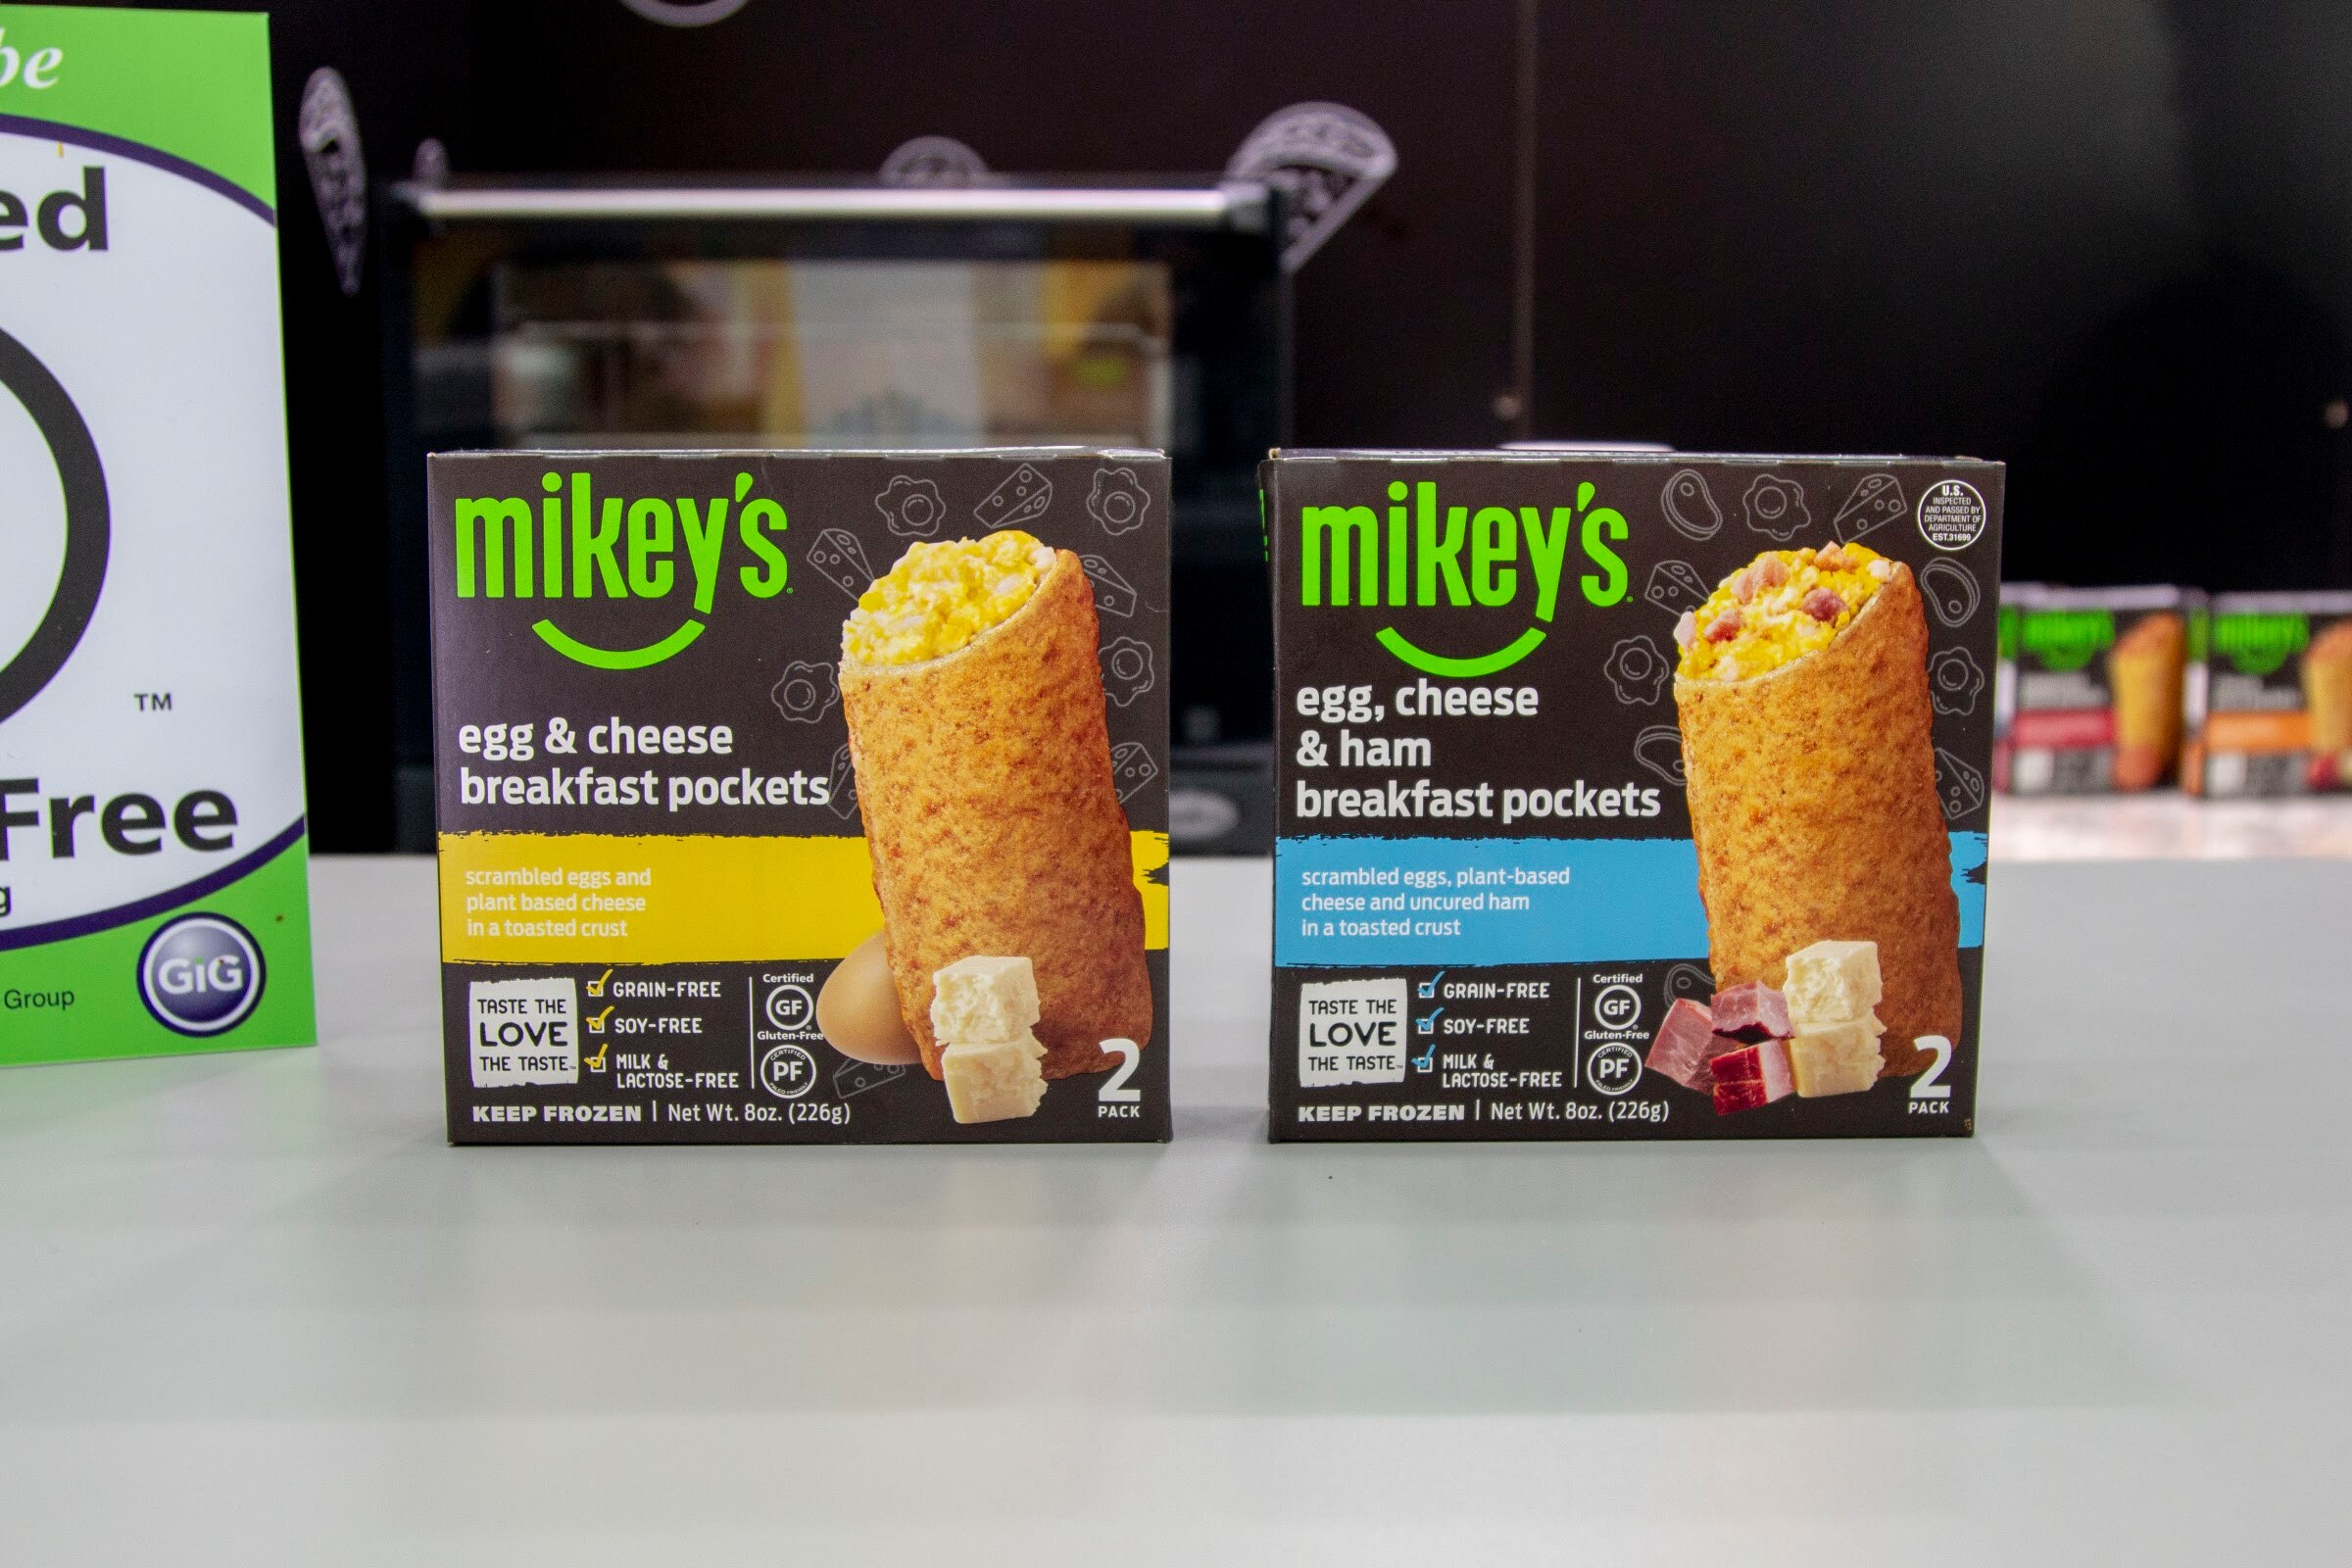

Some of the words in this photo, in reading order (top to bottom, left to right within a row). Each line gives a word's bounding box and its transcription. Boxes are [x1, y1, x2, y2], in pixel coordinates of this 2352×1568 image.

[1942, 485, 1964, 496] U.S.
[1926, 506, 1940, 514] AND
[1942, 506, 1969, 514] PASSED
[1971, 506, 1981, 514] BY
[1933, 497, 1972, 506] INSPECTED
[1972, 514, 1982, 523] OF
[1928, 523, 1977, 532] AGRICULTURE
[456, 472, 788, 614] mikey's
[1301, 480, 1629, 622] mikey's
[134, 693, 172, 711] TM
[1297, 684, 1385, 723] egg,
[1396, 678, 1539, 716] cheese
[459, 722, 534, 761] egg
[545, 716, 578, 755] &
[588, 716, 733, 755] cheese
[1296, 729, 1329, 766] &
[1340, 729, 1432, 766] ham
[461, 767, 659, 805] breakfast
[669, 767, 830, 812] pockets
[1297, 780, 1494, 817] breakfast
[1502, 780, 1661, 824] pockets
[0, 778, 238, 861] Free
[466, 868, 564, 886] scrambled
[567, 870, 612, 889] eggs
[615, 867, 652, 886] and
[1301, 867, 1398, 886] scrambled
[1403, 870, 1452, 889] eggs,
[1456, 866, 1570, 888] plant-based
[466, 894, 516, 913] plant
[520, 893, 577, 911] based
[581, 893, 646, 911] cheese
[1301, 893, 1367, 911] cheese
[1370, 893, 1405, 911] and
[1409, 893, 1484, 910] uncured
[1489, 892, 1530, 910] ham
[466, 919, 485, 937] in
[488, 923, 500, 937] a
[504, 919, 576, 937] toasted
[581, 920, 628, 937] crust
[1301, 918, 1319, 936] in
[1323, 922, 1335, 936] a
[1339, 918, 1411, 936] toasted
[1415, 919, 1461, 936] crust
[158, 954, 243, 995] GiG
[762, 973, 814, 983] Certified
[1592, 973, 1643, 984] Certified
[612, 981, 721, 998] GRAIN-FREE
[1444, 982, 1550, 1000] GRAIN-FREE
[4, 989, 75, 1010] Group
[477, 999, 527, 1014] TASTE
[534, 999, 566, 1013] THE
[775, 1000, 803, 1015] GF
[1308, 1000, 1358, 1015] TASTE
[1366, 999, 1397, 1014] THE
[1603, 1000, 1631, 1015] GF
[479, 1021, 567, 1048] LOVE
[614, 1018, 703, 1034] SOY-FREE
[1309, 1021, 1397, 1048] LOVE
[1444, 1018, 1530, 1035] SOY-FREE
[757, 1031, 823, 1041] Gluten-Free
[1584, 1030, 1650, 1040] Gluten-Free
[770, 1049, 806, 1061] CERTIFIED
[1597, 1047, 1633, 1058] CERTIFIED
[479, 1056, 512, 1072] THE
[616, 1054, 651, 1070] MILK
[658, 1054, 668, 1070] &
[1098, 1037, 1141, 1102] 2
[1308, 1056, 1342, 1072] THE
[1443, 1054, 1478, 1070] MILK
[1484, 1054, 1494, 1070] &
[1599, 1058, 1630, 1079] PF
[1909, 1034, 1951, 1099] 2
[773, 1061, 804, 1082] PF
[616, 1073, 739, 1089] LACTOSE-FREE
[1442, 1072, 1563, 1089] LACTOSE-FREE
[472, 1105, 537, 1122] KEEP
[544, 1105, 642, 1122] FROZEN
[668, 1104, 701, 1121] Net
[704, 1103, 739, 1121] Wt.
[744, 1103, 782, 1121] 8oz.
[788, 1102, 851, 1125] (226g)
[1098, 1104, 1141, 1118] PACK
[1298, 1105, 1362, 1122] KEEP
[1368, 1104, 1465, 1122] FROZEN
[1491, 1102, 1523, 1121] Net
[1525, 1102, 1560, 1120] Wt.
[1566, 1102, 1603, 1120] 8oz.
[1608, 1101, 1669, 1123] (226g)
[1908, 1101, 1950, 1114] PACK
